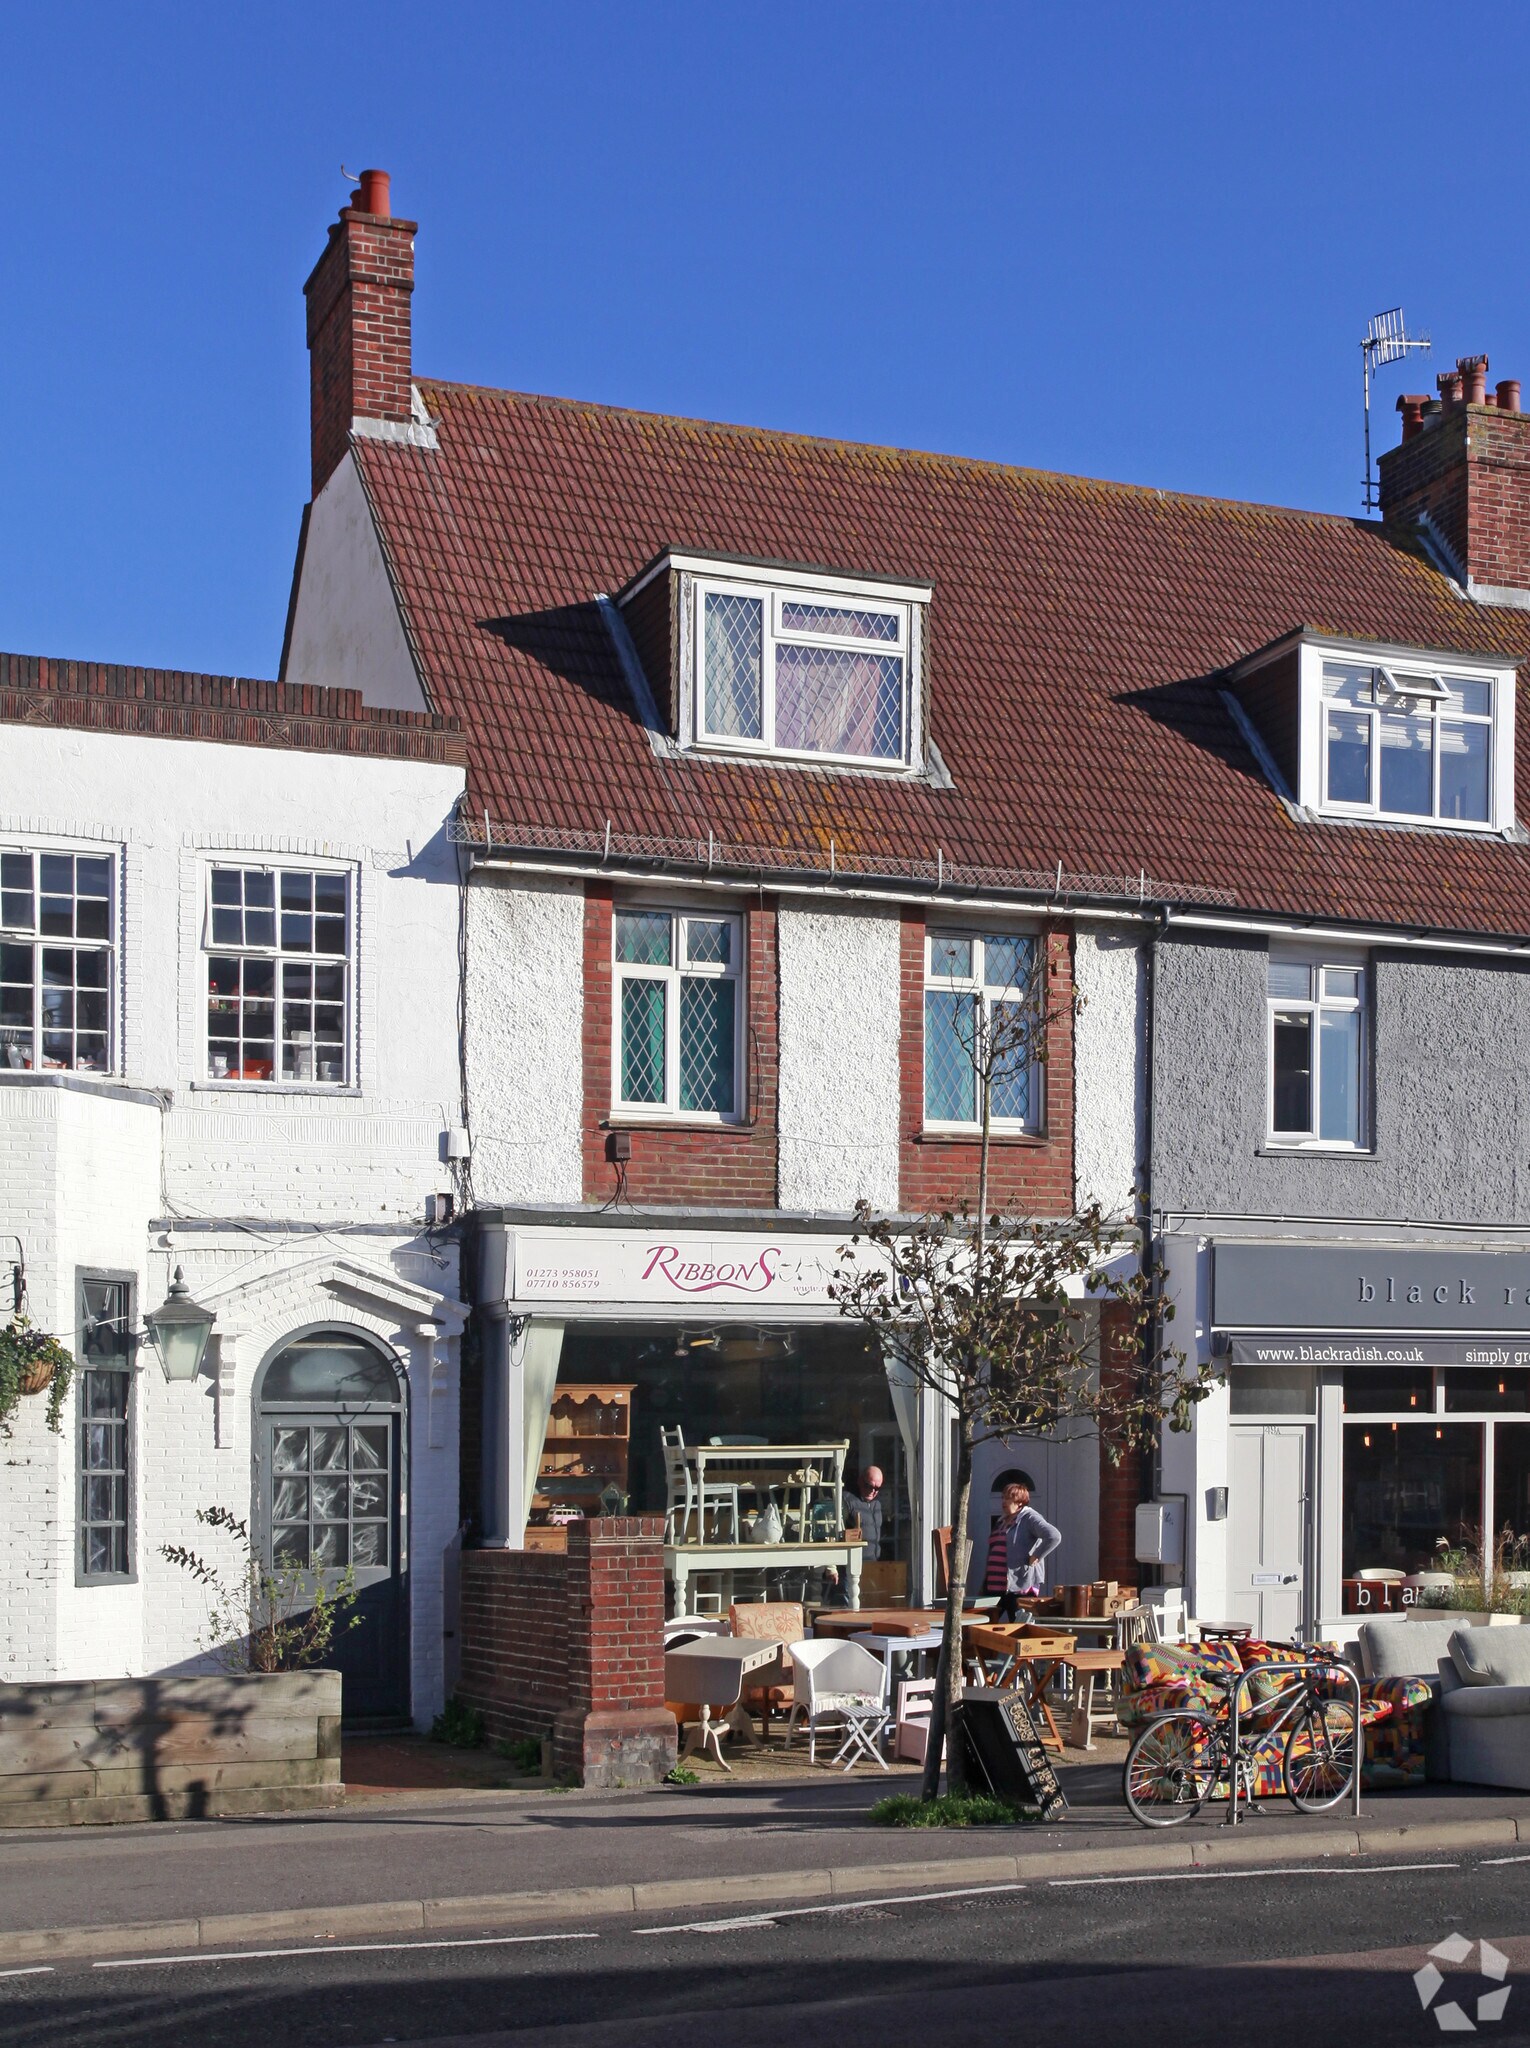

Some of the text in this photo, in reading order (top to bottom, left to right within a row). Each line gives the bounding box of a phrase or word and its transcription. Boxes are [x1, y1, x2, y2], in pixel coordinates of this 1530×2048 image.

[526, 1268, 600, 1278] 01273 958051
[526, 1279, 600, 1289] 07710 856579
[1358, 1276, 1530, 1306] black r
[1256, 1346, 1530, 1365] www.blackradish.co.uk simply gr
[1356, 1582, 1415, 1606] bla
